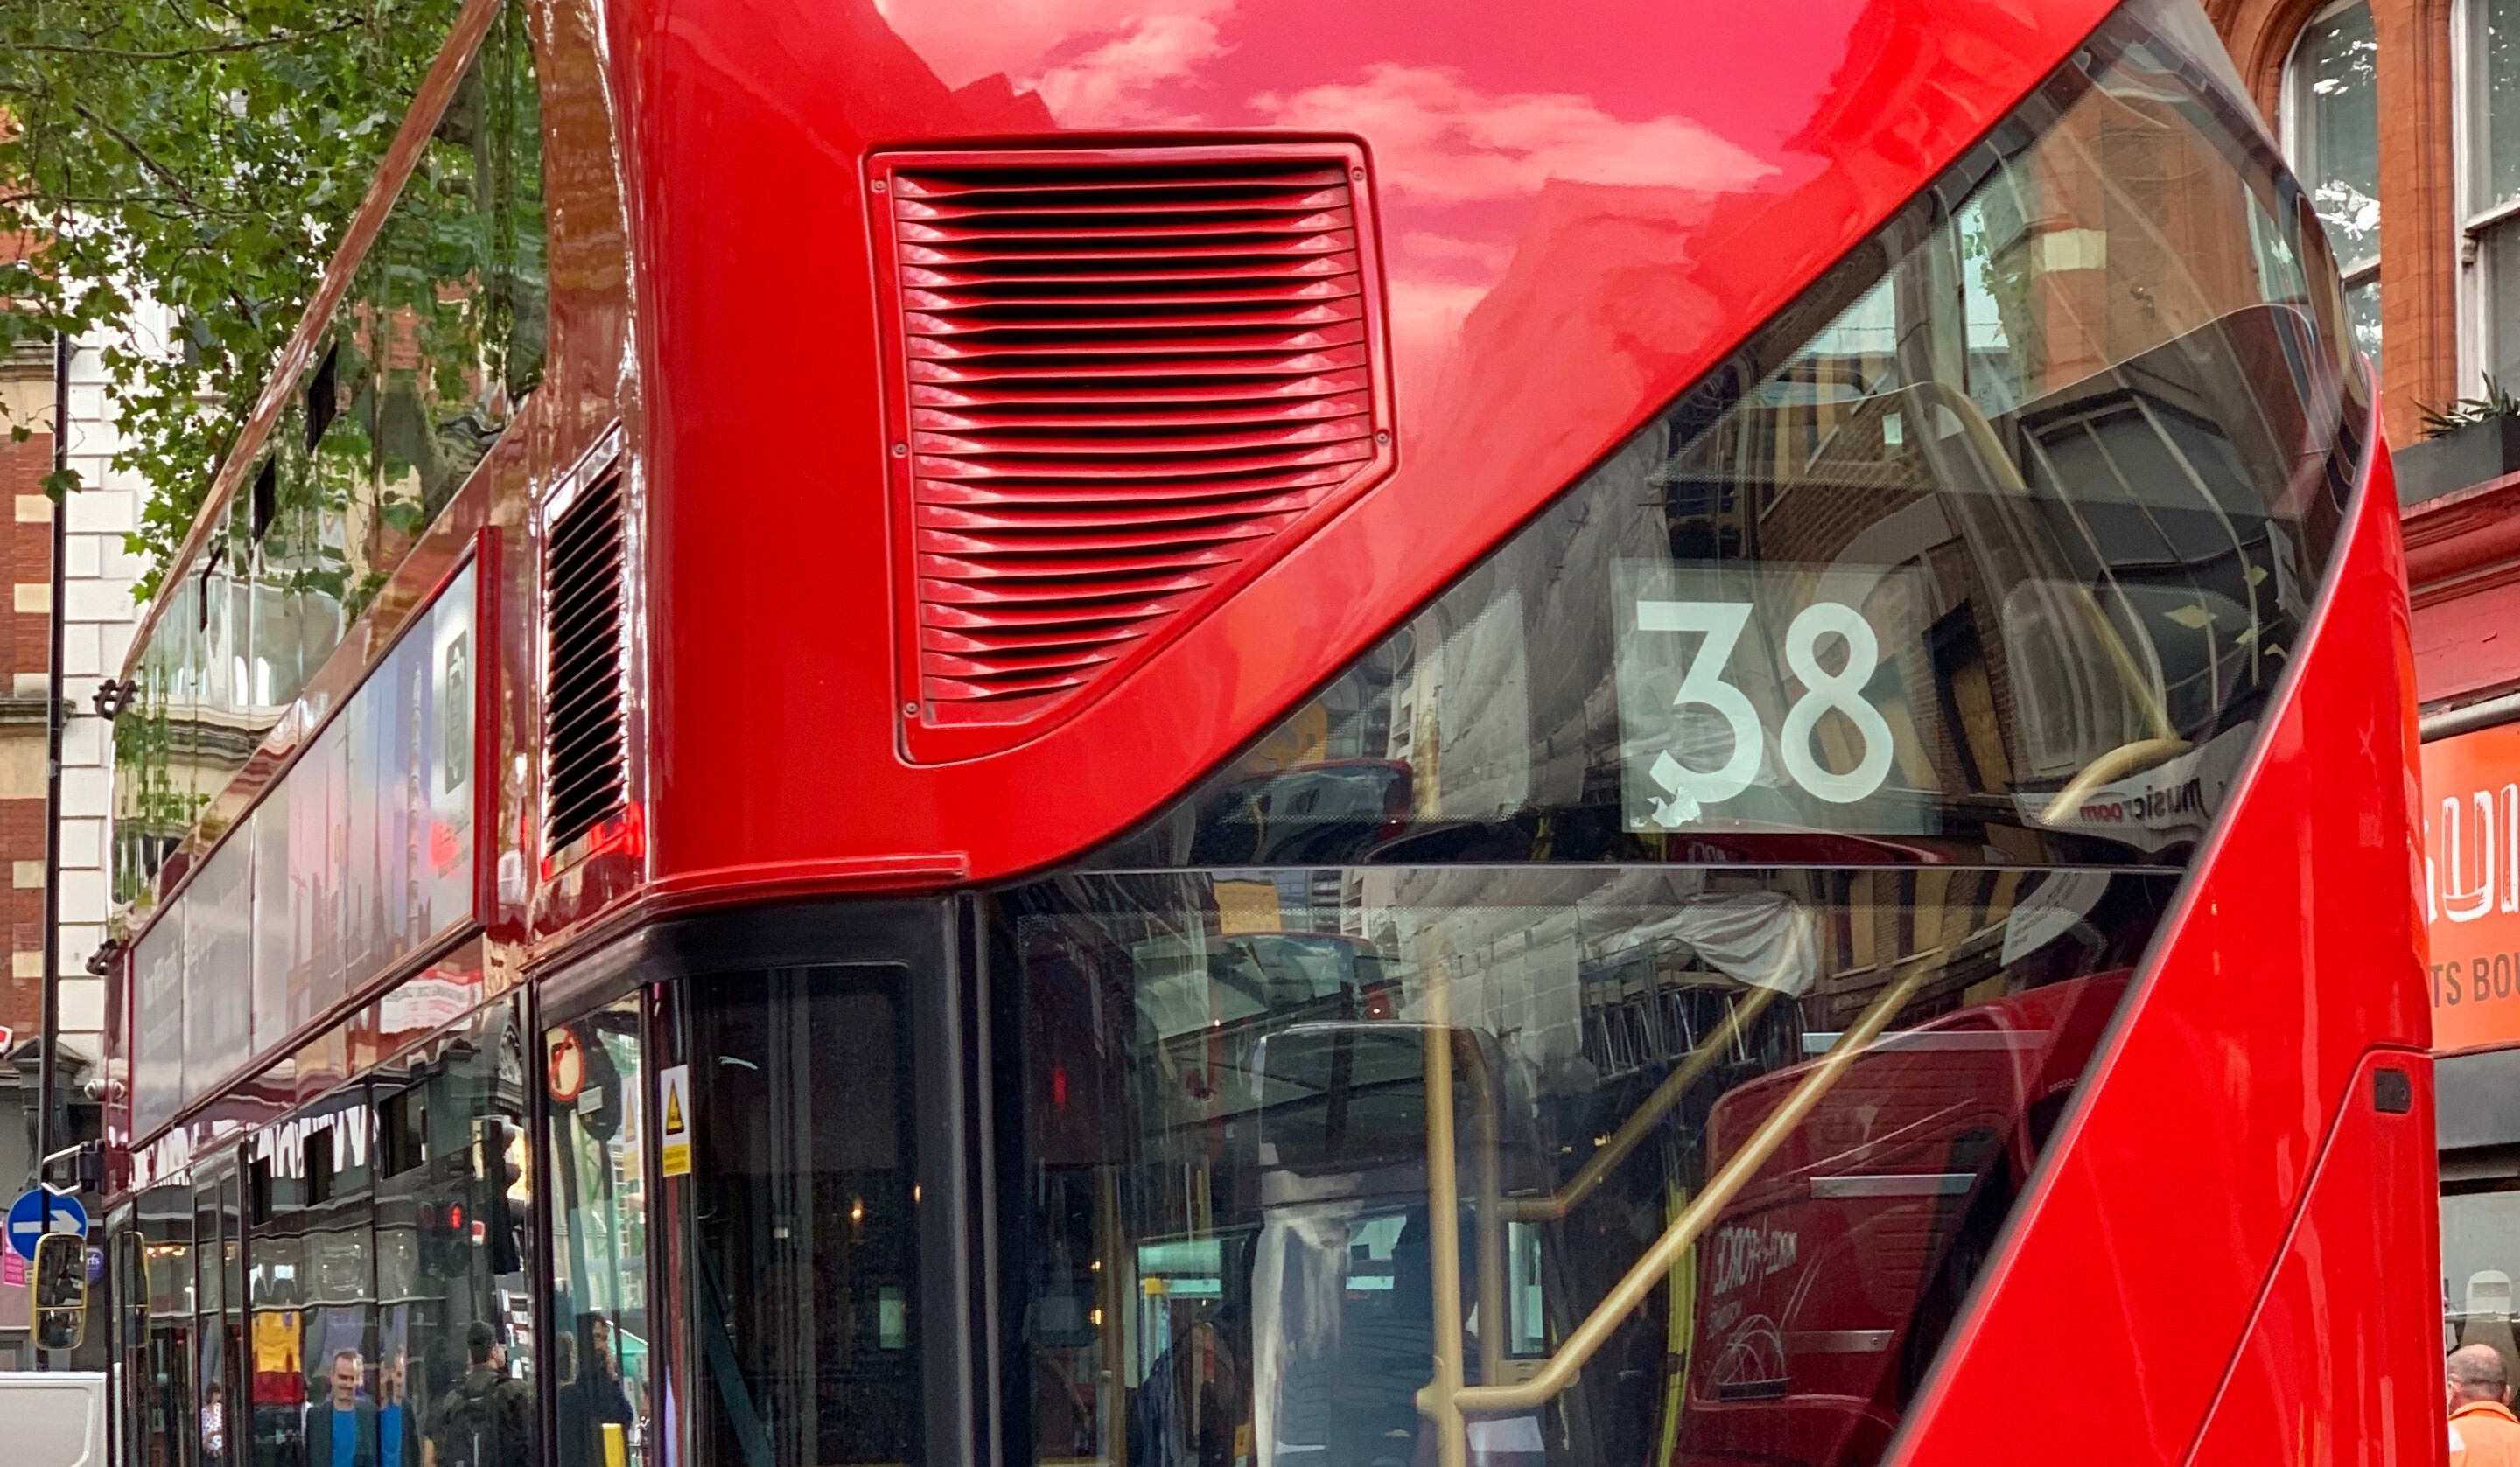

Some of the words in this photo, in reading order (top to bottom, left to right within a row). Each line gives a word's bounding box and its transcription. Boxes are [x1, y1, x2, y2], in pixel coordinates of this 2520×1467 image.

[1636, 600, 1894, 803] 38
[2425, 782, 2519, 925] UI
[2430, 960, 2462, 1009] TS
